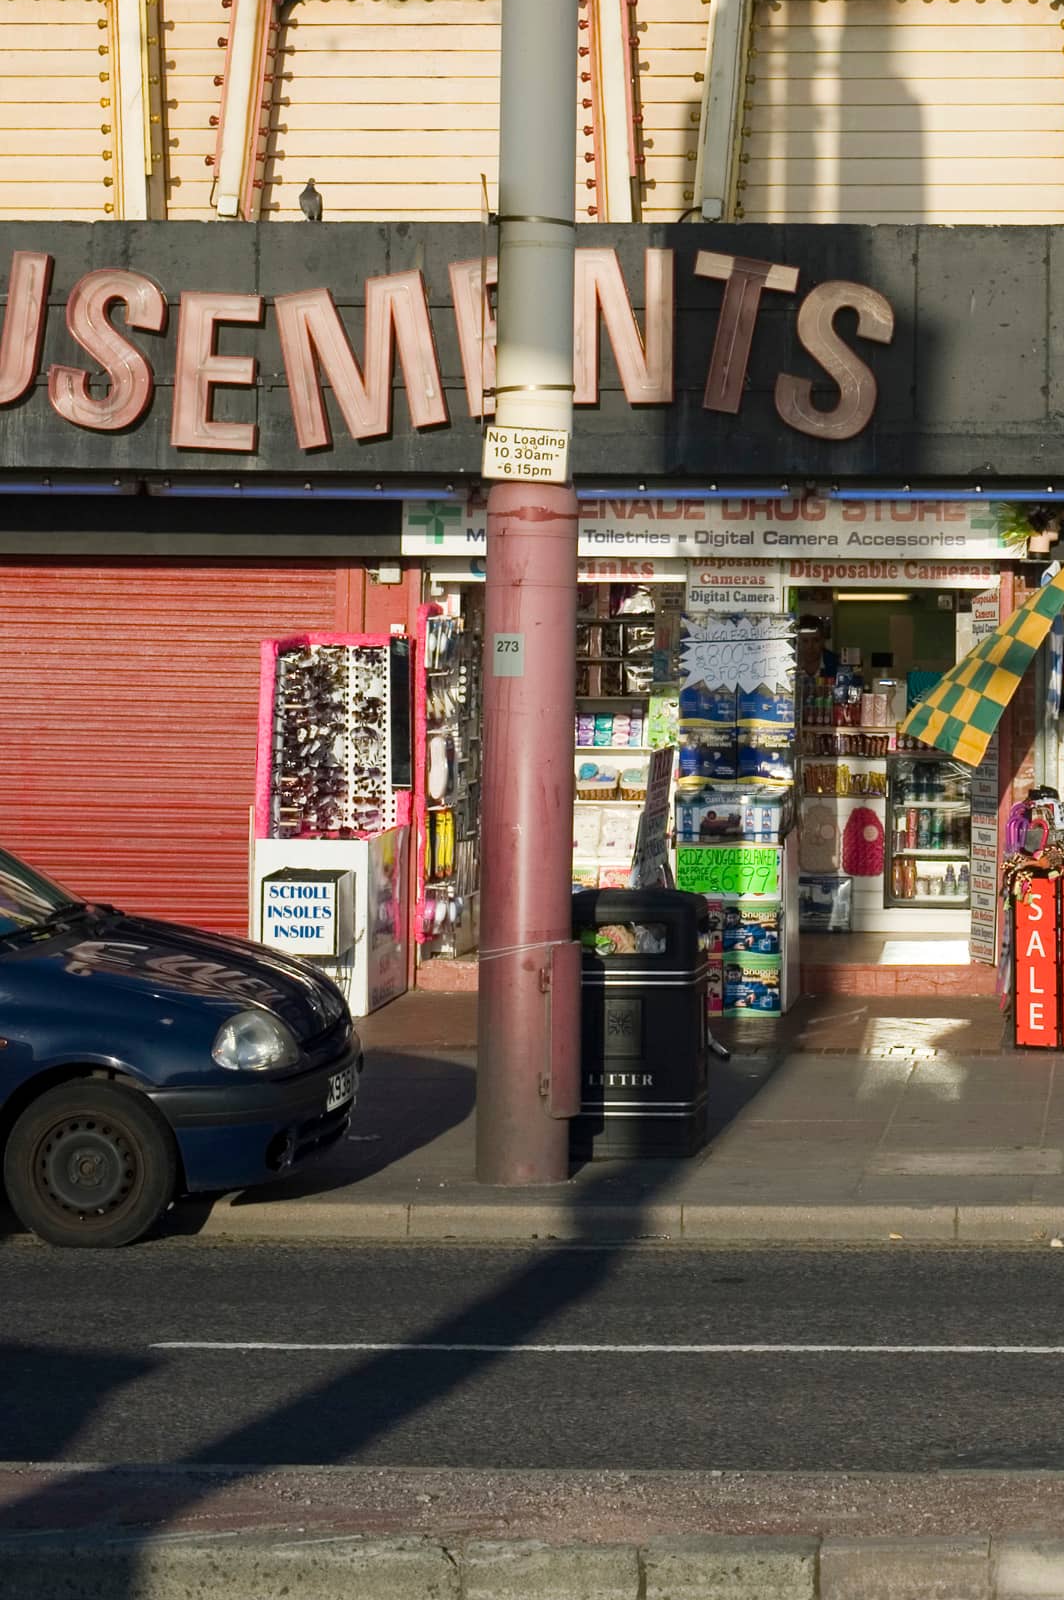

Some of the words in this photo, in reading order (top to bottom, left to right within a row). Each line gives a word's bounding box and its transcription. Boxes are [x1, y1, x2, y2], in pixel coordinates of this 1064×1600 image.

[488, 431, 508, 443] No
[513, 433, 566, 449] Loading
[584, 528, 671, 544] Toiletries
[694, 530, 755, 547] Digital
[763, 531, 839, 546] Camera
[847, 531, 967, 547] Accessories
[789, 559, 898, 582] Disposable
[903, 560, 991, 581] Cameras
[700, 573, 767, 586] Cameras
[496, 641, 520, 653] 273
[678, 849, 702, 866] KIDZ
[269, 886, 331, 899] SCHOLL
[267, 905, 332, 919] INSOLES
[274, 925, 325, 938] INSIDE
[1026, 893, 1046, 1031] SALE
[588, 1073, 654, 1086] LITTER
